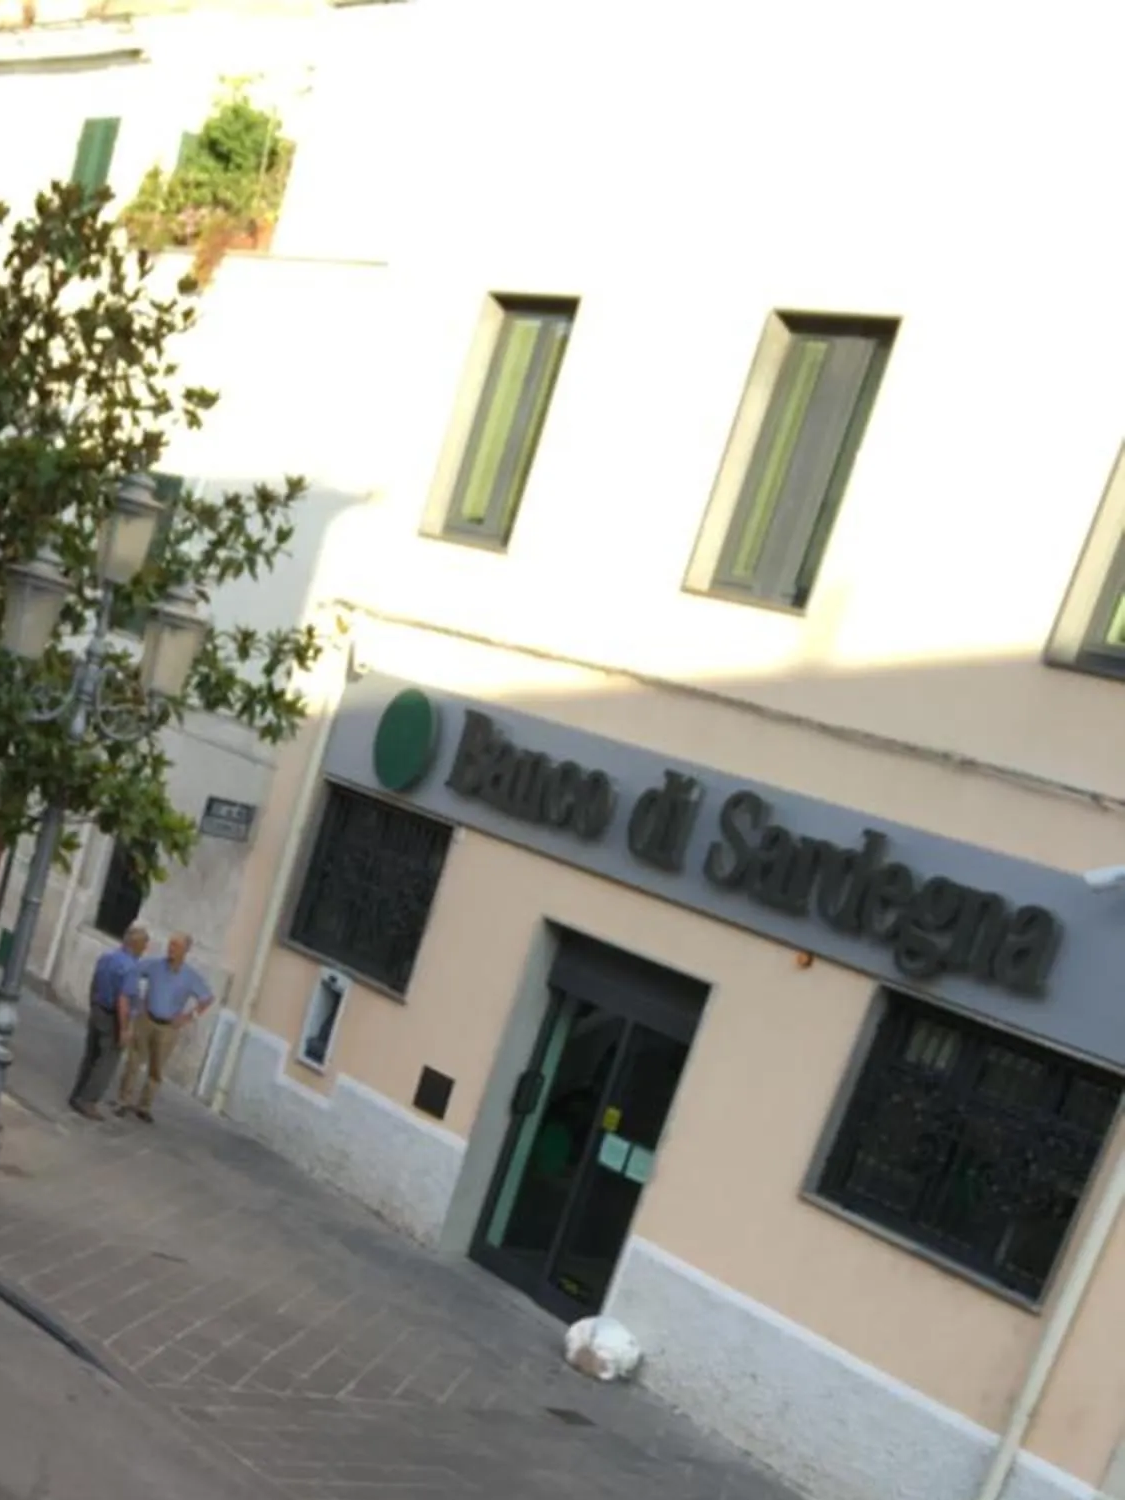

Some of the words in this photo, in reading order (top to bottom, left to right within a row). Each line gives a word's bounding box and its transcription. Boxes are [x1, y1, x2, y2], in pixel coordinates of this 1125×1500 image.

[445, 708, 616, 843] Banco
[627, 768, 702, 875] di
[702, 789, 1062, 1000] Sardegna
